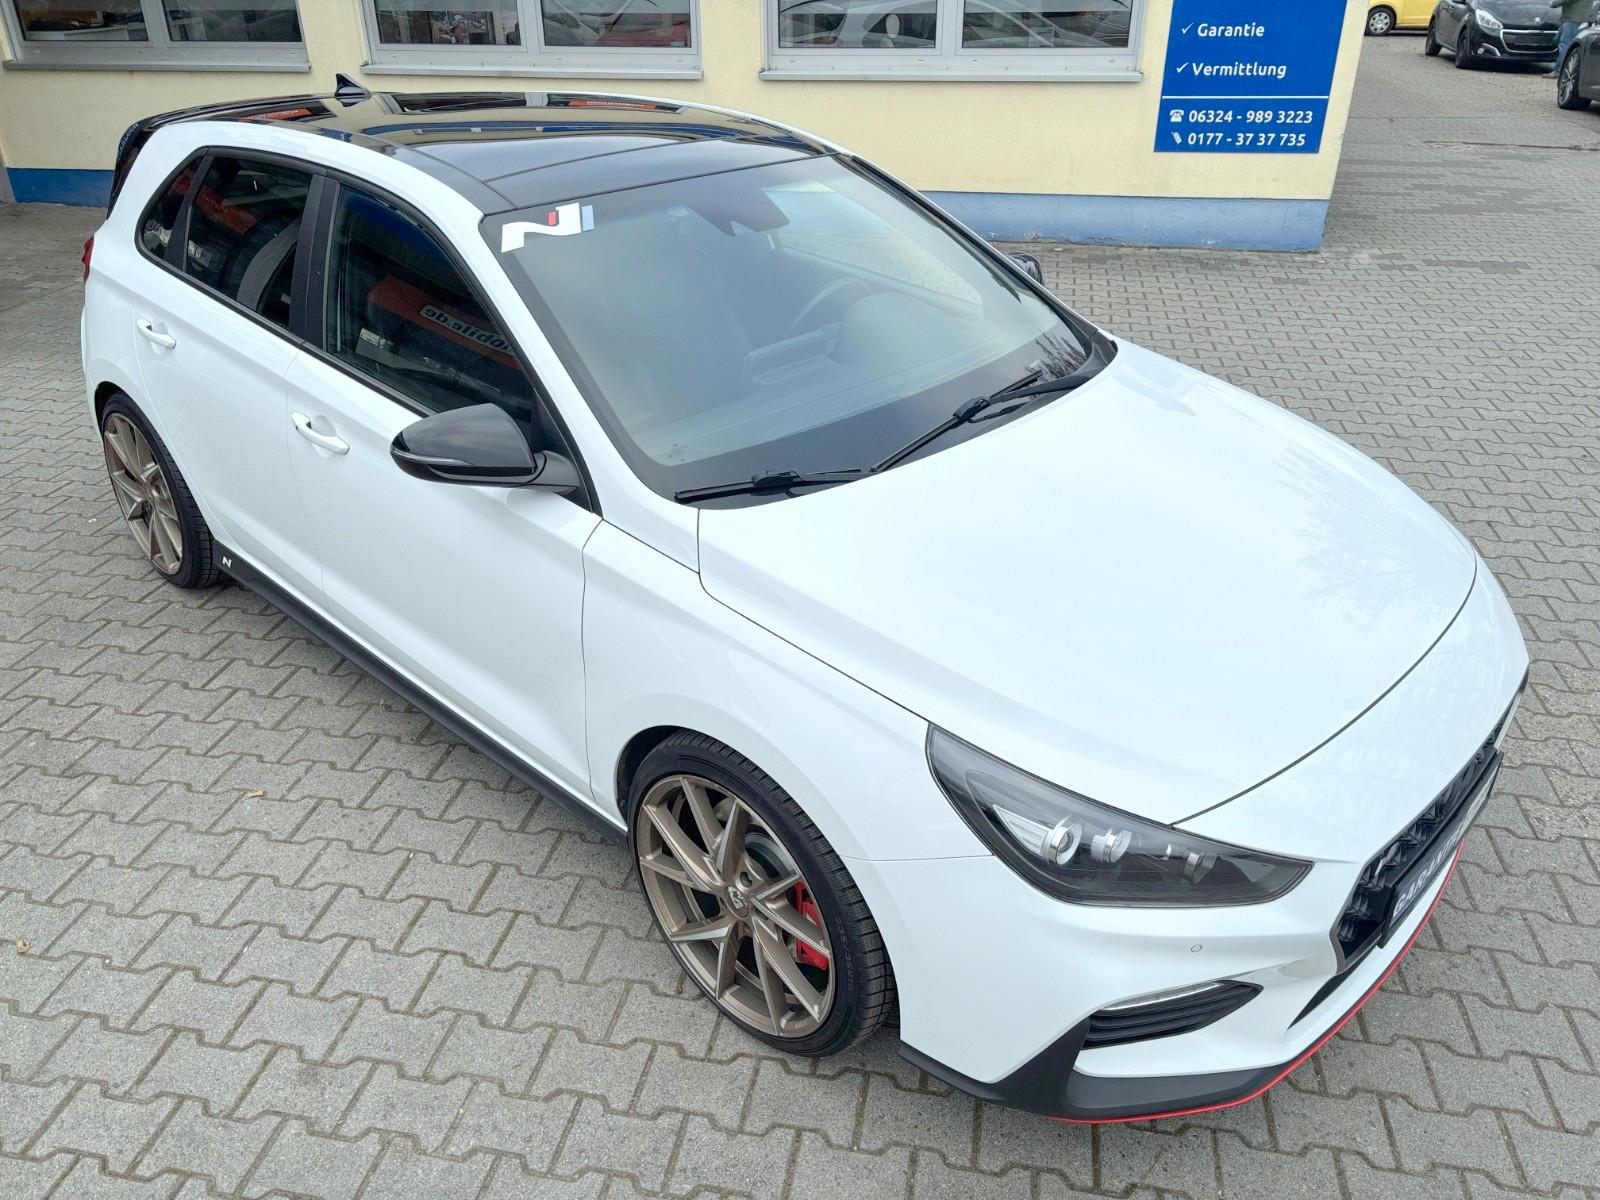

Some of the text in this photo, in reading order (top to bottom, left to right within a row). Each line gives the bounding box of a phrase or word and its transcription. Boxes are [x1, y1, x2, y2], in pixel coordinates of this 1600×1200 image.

[1197, 22, 1265, 37] Garantie
[1192, 62, 1287, 79] Vermittlung
[1188, 110, 1233, 123] 06324
[1246, 110, 1273, 123] 989
[1276, 110, 1313, 124] 3223
[1187, 132, 1224, 145] 0177
[1235, 132, 1254, 146] 37
[1257, 133, 1276, 146] 37
[1279, 133, 1306, 146] 735
[222, 556, 232, 568] N
